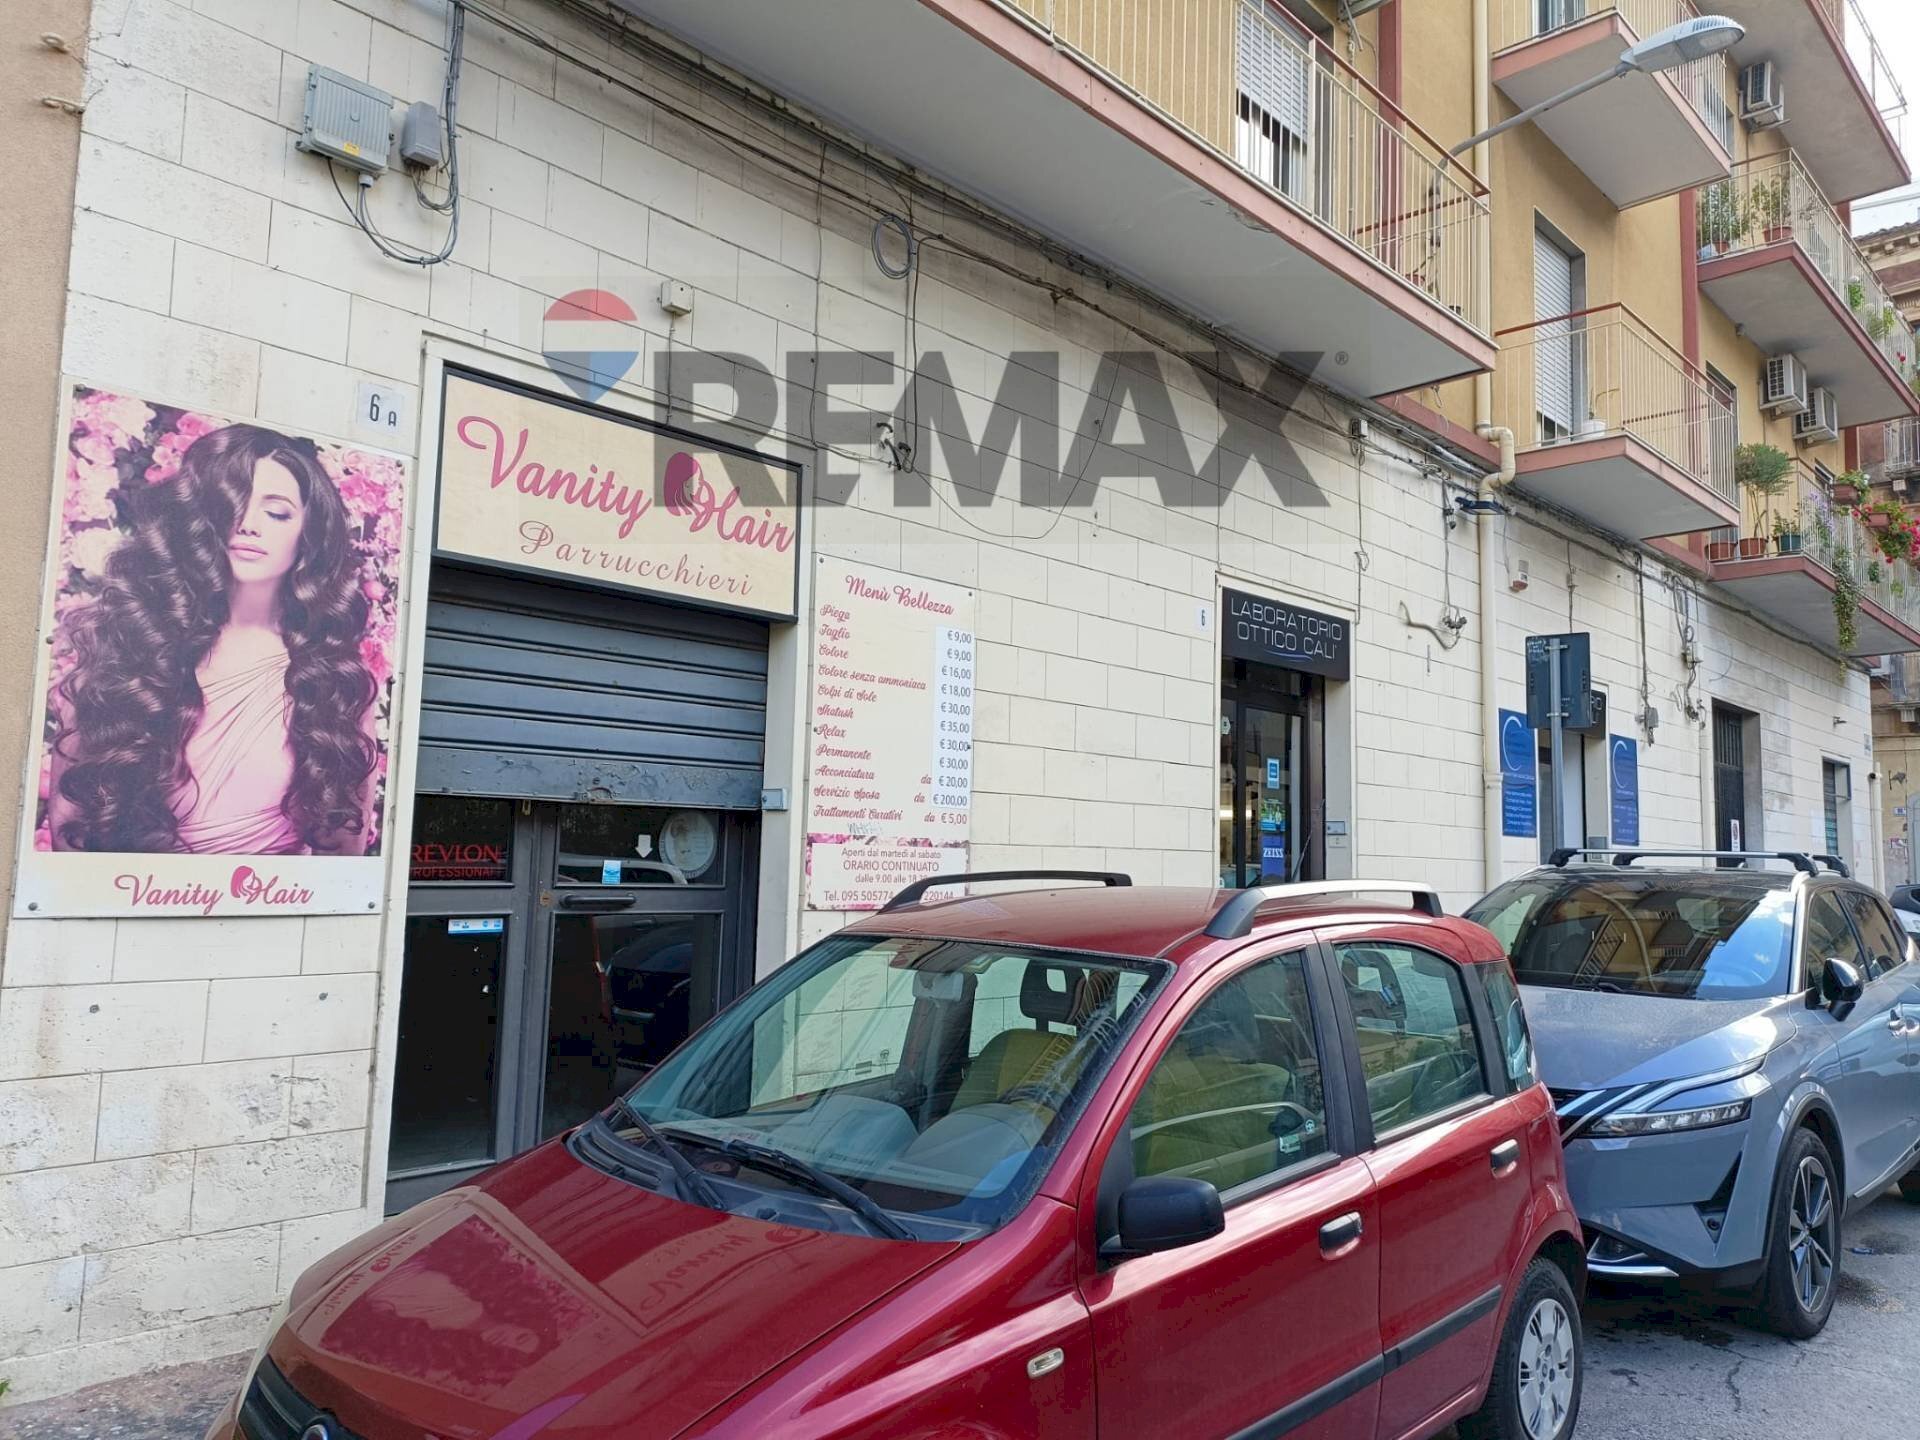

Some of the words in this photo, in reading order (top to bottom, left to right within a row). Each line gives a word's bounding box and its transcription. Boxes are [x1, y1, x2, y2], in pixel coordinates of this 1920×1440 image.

[370, 393, 380, 422] 6
[388, 411, 397, 426] A
[457, 415, 652, 539] Vanity
[689, 480, 795, 553] Hair
[519, 520, 752, 595] Parrucchieri
[845, 575, 891, 601] Menù
[893, 585, 954, 615] Bellezza
[820, 604, 850, 622] Piega
[1231, 598, 1342, 640] LABORATORIO
[819, 624, 850, 640] Taglio
[1237, 621, 1297, 651] OTTICO
[819, 644, 848, 659] Colore
[818, 664, 848, 679] Colore
[850, 671, 876, 682] senza
[878, 677, 927, 690] ammoniaca
[817, 684, 842, 699] Colpi
[844, 688, 854, 698] di
[856, 690, 877, 702] Sole
[816, 724, 846, 740] Relax
[816, 744, 872, 760] Permanente
[815, 765, 875, 780] Acconciatura
[920, 774, 932, 784] da
[814, 784, 850, 798] Servizio
[854, 788, 880, 802] Sposa
[914, 792, 925, 802] da
[814, 805, 866, 818] Trattamenti
[868, 808, 904, 820] Curativi
[924, 812, 935, 822] da
[412, 844, 499, 864] REVLON
[842, 848, 866, 859] Aperti
[868, 848, 880, 857] dal
[909, 848, 916, 858] al
[918, 849, 941, 859] sabato
[844, 860, 878, 870] ORARIO
[882, 860, 940, 872] CONTINUATO
[856, 874, 874, 883] dalle
[894, 874, 906, 884] alle
[114, 874, 224, 915] Vanity
[246, 876, 314, 905] Hair
[824, 890, 840, 900] Tel.
[842, 890, 859, 900] 095
